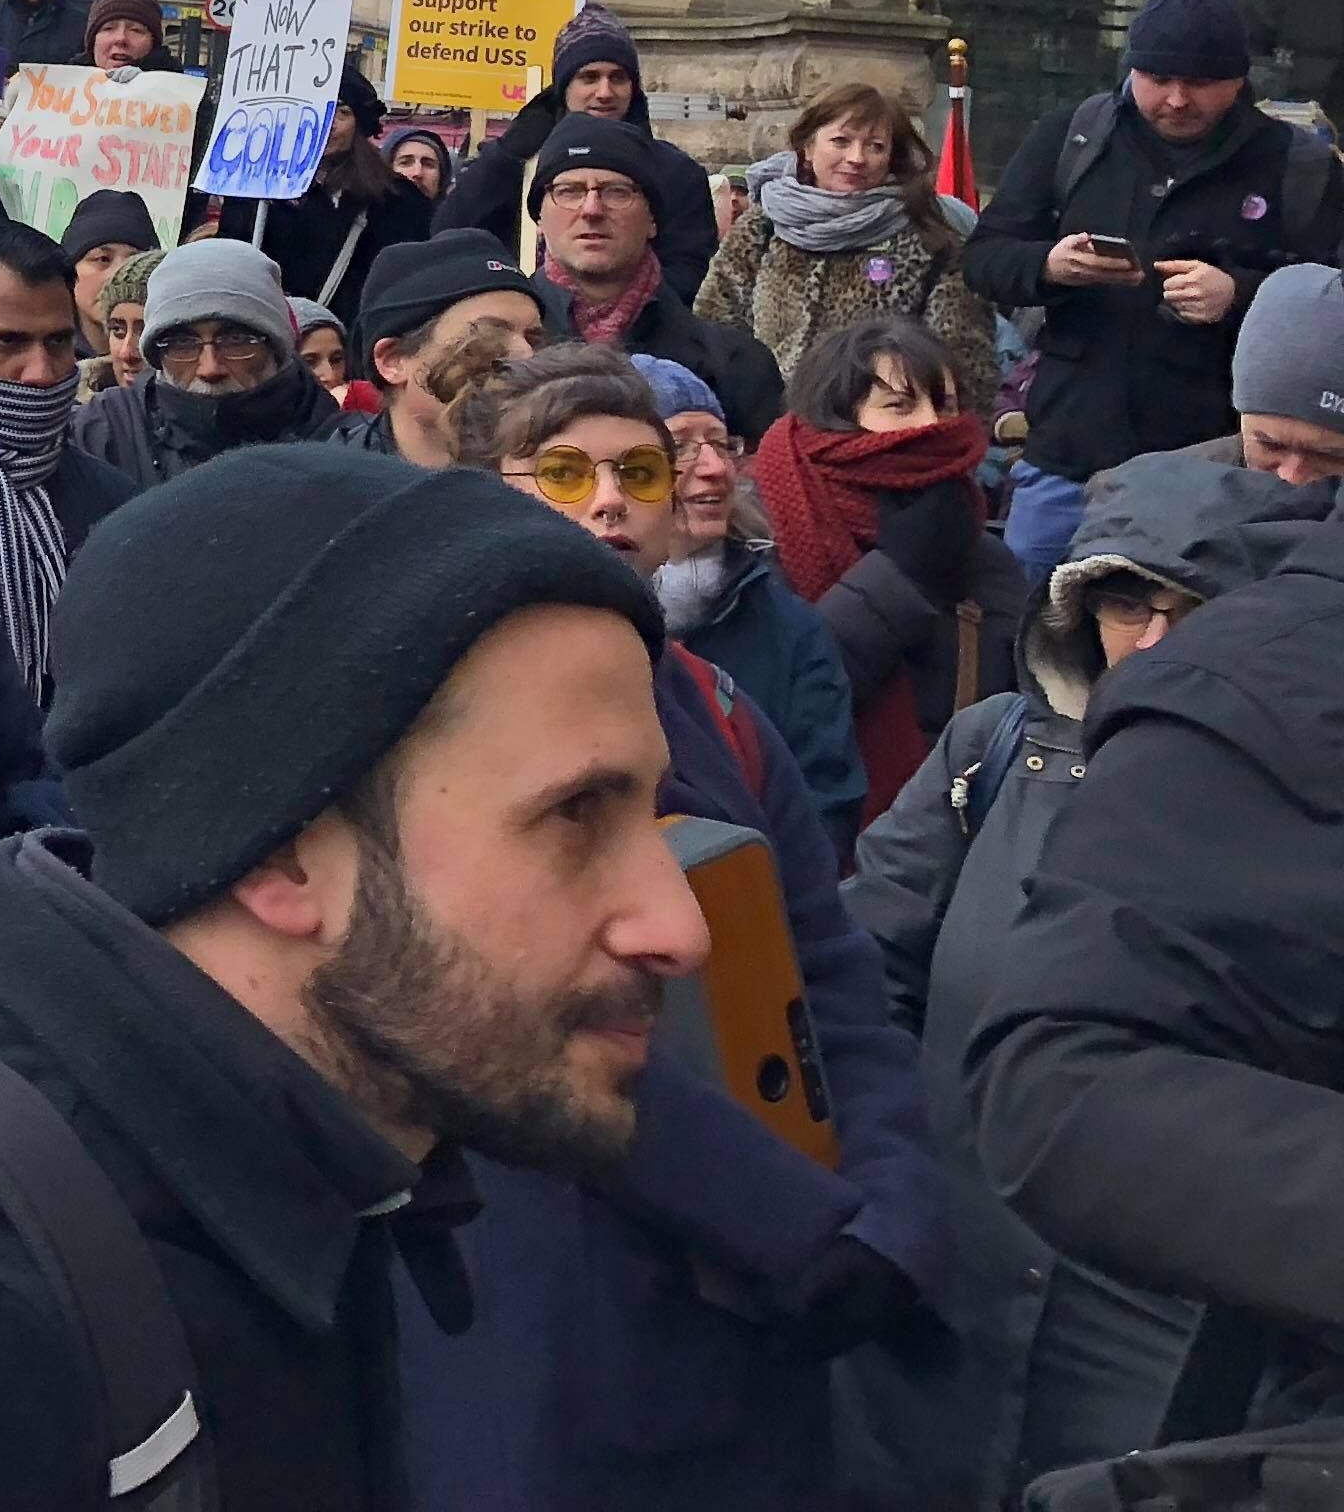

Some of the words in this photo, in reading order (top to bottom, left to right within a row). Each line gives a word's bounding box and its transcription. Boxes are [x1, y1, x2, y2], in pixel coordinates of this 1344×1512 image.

[409, 19, 445, 34] our
[449, 20, 509, 39] strike
[515, 25, 536, 41] to
[230, 38, 335, 97] THAT'S
[407, 41, 478, 63] defend
[485, 48, 527, 66] USS
[92, 135, 191, 188] STAFF
